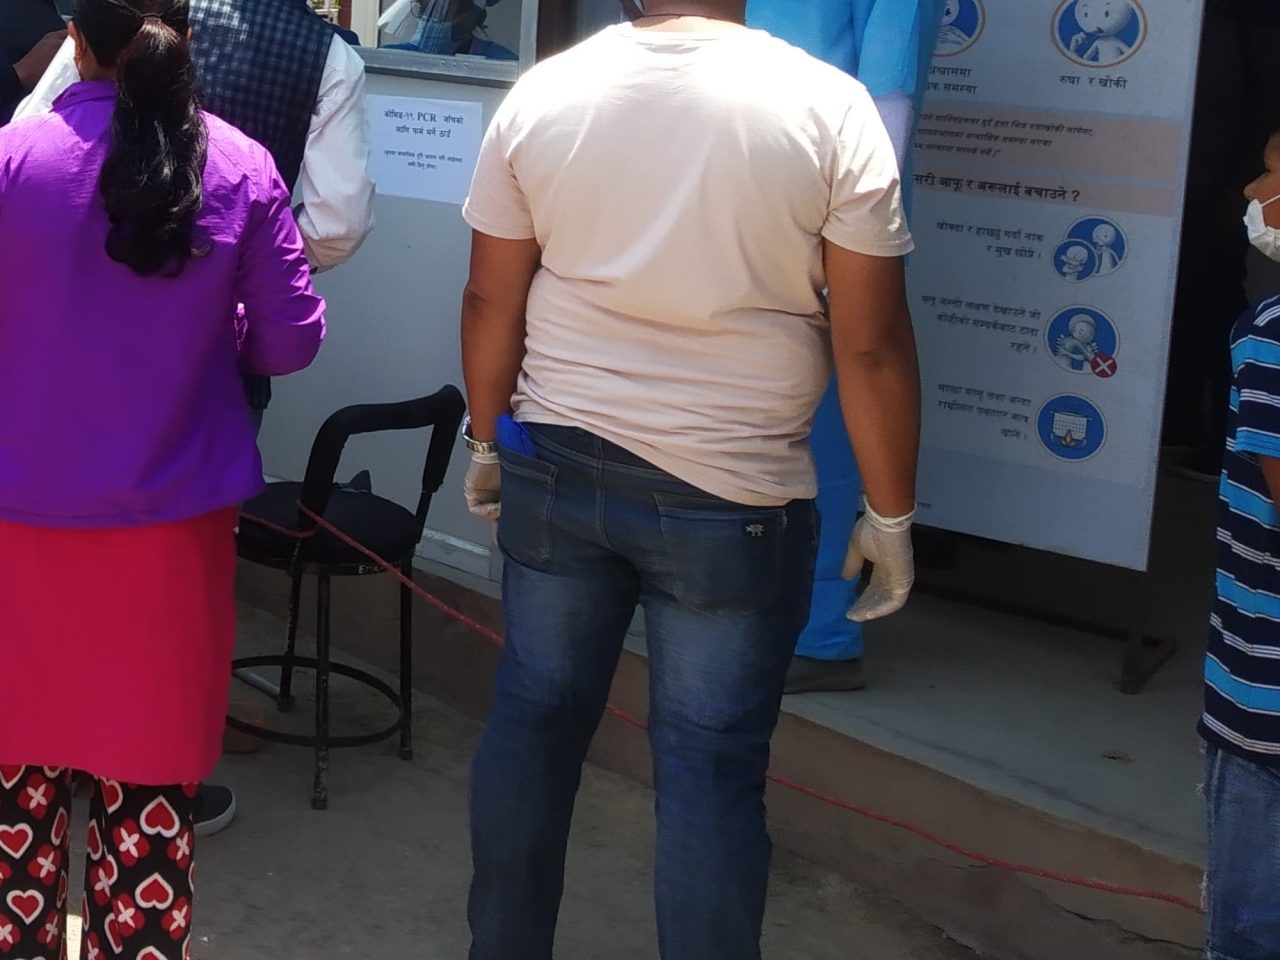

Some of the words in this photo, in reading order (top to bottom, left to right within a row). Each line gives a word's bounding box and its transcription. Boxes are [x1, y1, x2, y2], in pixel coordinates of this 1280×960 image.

[942, 83, 978, 95] समस्या
[1087, 76, 1096, 86] र
[1098, 74, 1128, 90] खोकी
[384, 108, 414, 121] कोभिड-१९
[418, 111, 436, 123] PCR
[396, 123, 410, 134] लागि
[412, 125, 424, 136] फर्म
[938, 175, 964, 192] आफू
[966, 178, 976, 189] र
[1024, 185, 1068, 201] बचाउने
[966, 224, 973, 233] र
